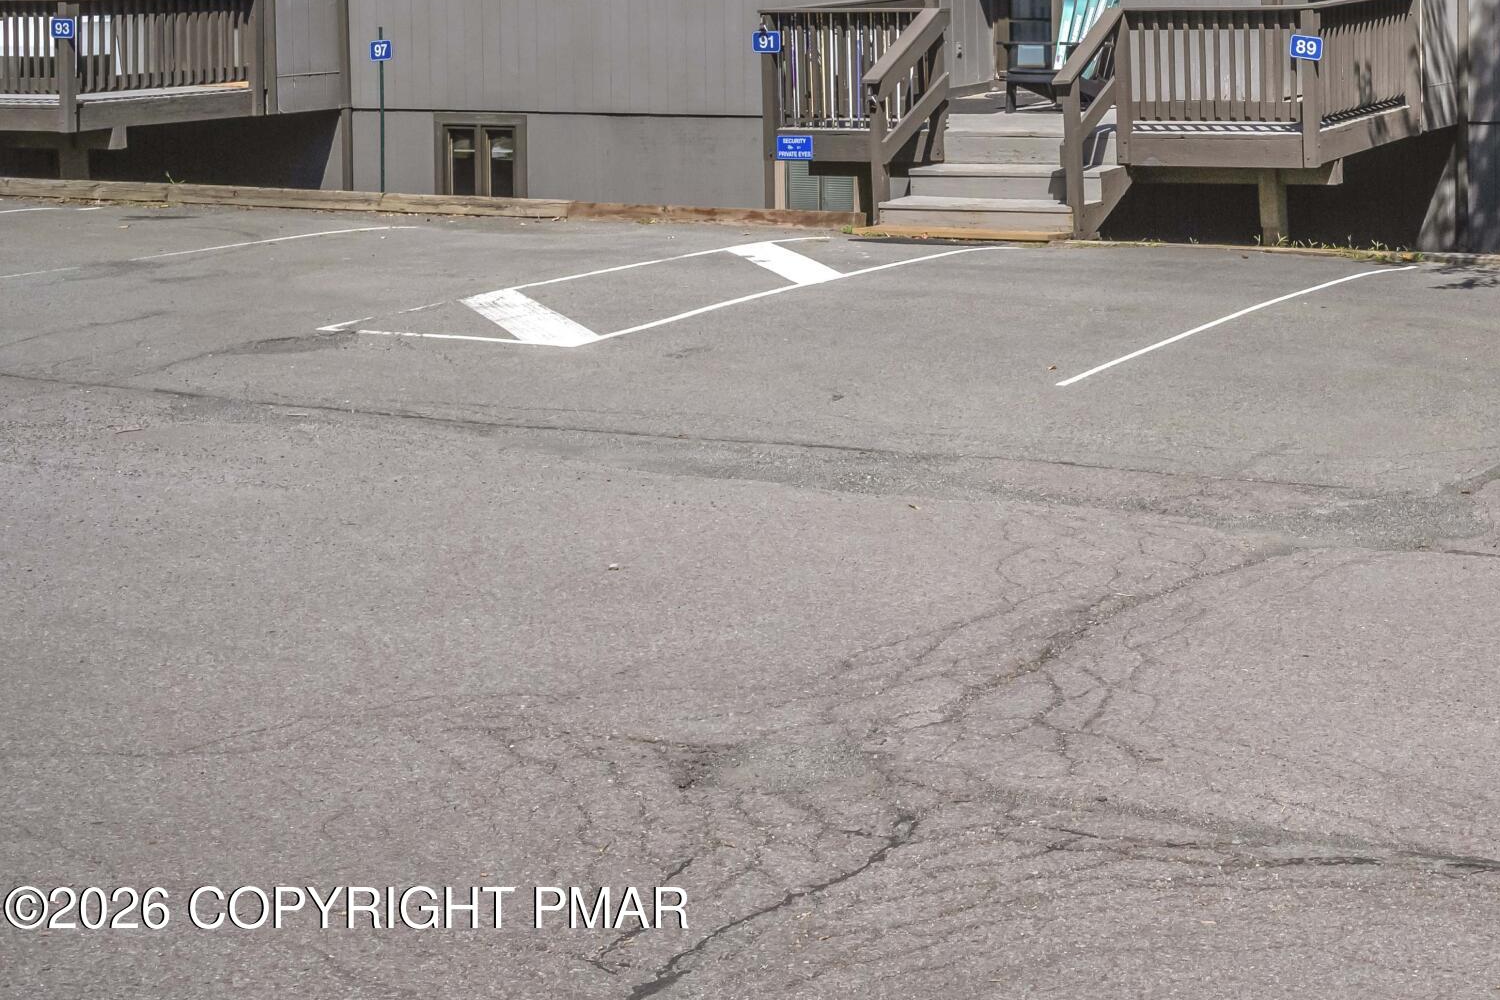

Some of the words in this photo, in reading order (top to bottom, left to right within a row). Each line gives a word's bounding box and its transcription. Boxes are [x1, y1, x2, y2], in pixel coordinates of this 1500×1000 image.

[55, 22, 70, 35] 93
[759, 35, 774, 49] 91
[1295, 39, 1317, 55] 89
[374, 43, 388, 57] 97
